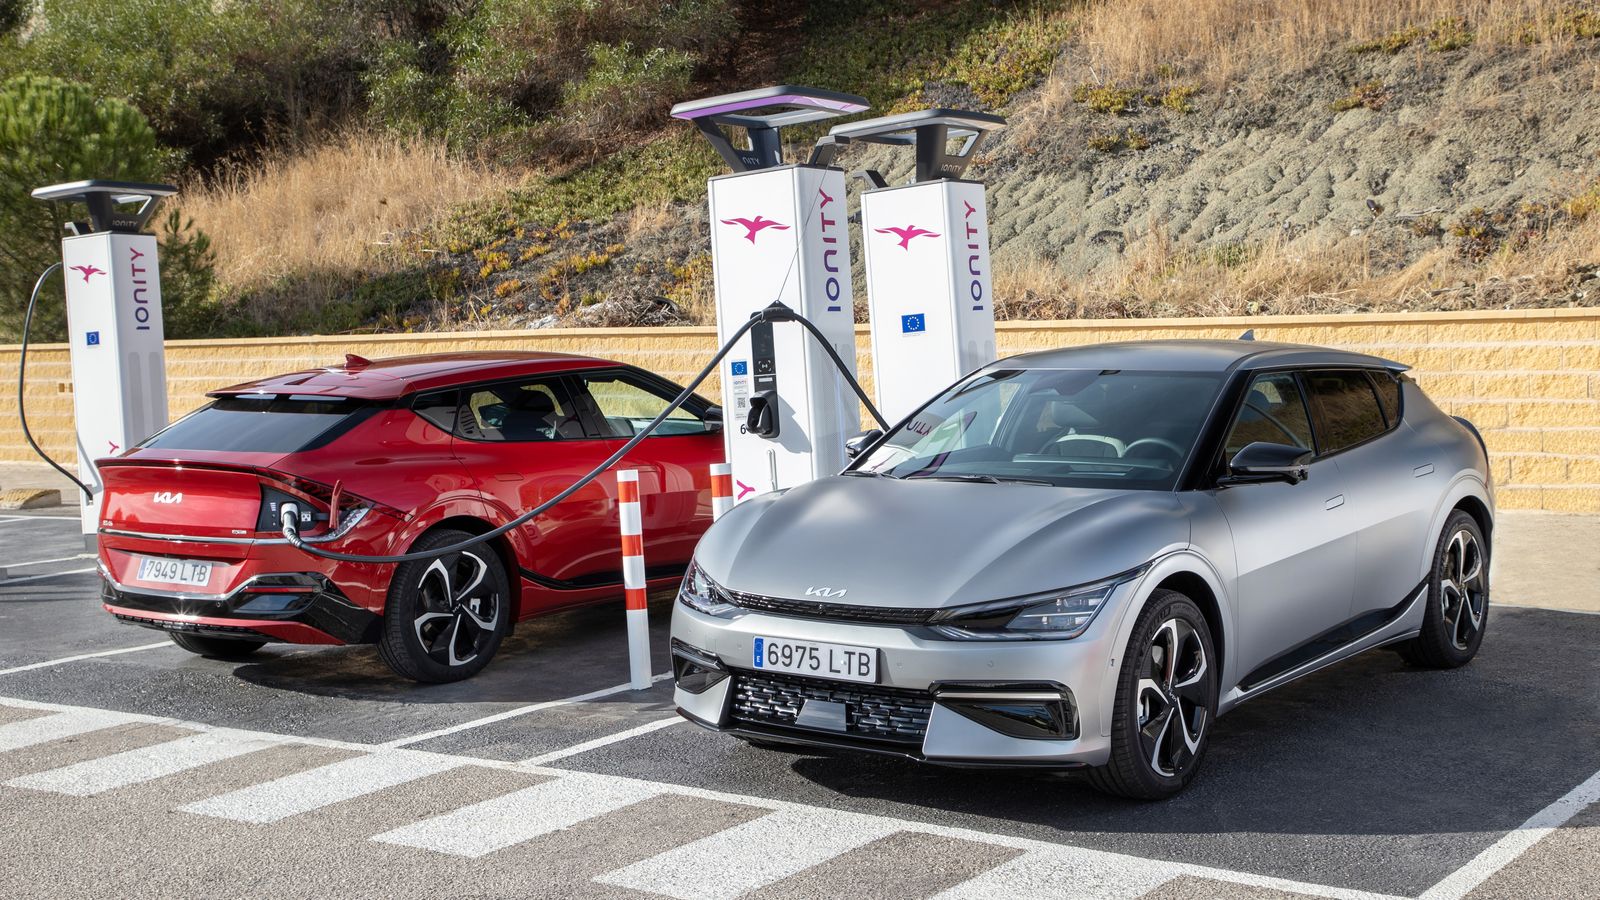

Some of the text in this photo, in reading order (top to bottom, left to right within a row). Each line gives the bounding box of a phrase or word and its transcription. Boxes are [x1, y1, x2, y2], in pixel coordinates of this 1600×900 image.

[742, 156, 760, 165] NITY
[112, 219, 138, 227] IONITY
[819, 187, 842, 312] IONITY
[964, 199, 984, 311] IONITY
[130, 247, 150, 330] IONITY
[740, 423, 747, 435] 6
[153, 491, 183, 504] KIA
[147, 560, 208, 582] 7949 LTB
[804, 586, 848, 598] KIA
[756, 642, 871, 677] E 6975 LTB
